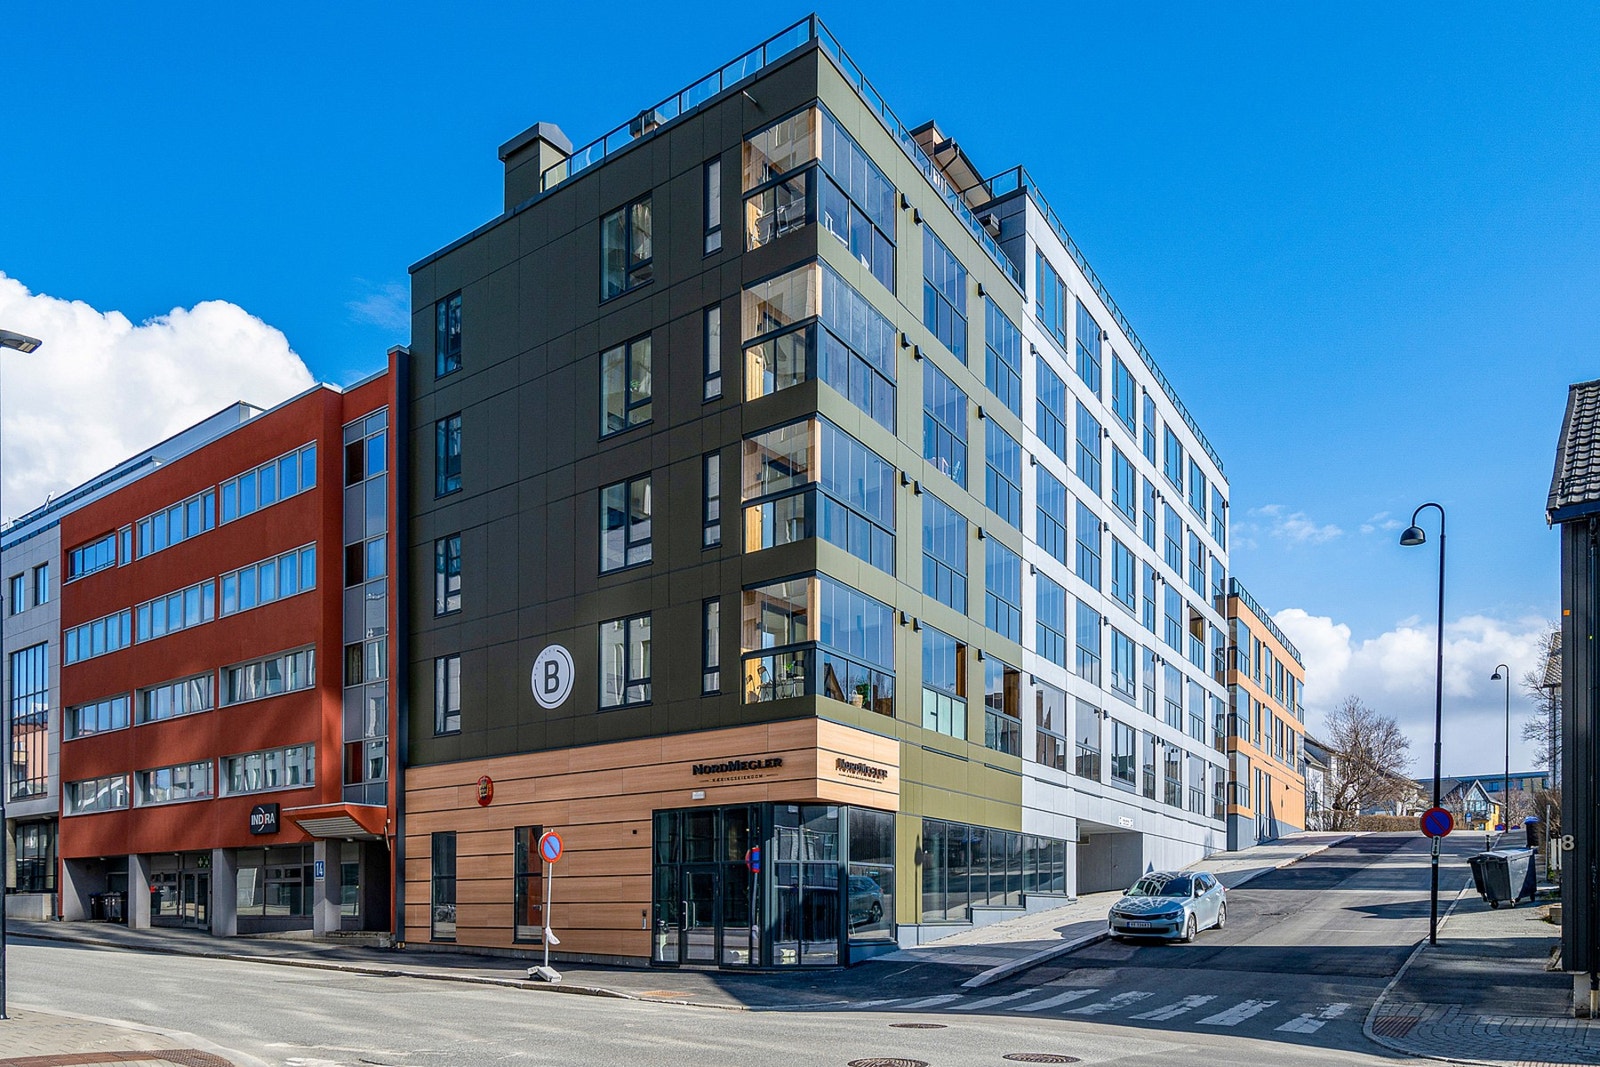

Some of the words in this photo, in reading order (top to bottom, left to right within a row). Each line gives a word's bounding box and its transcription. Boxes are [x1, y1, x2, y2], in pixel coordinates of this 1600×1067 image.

[545, 660, 560, 694] B
[692, 758, 783, 775] NORDMEGLER
[251, 813, 275, 825] INDRA
[1562, 834, 1575, 850] 8
[316, 862, 323, 876] 14
